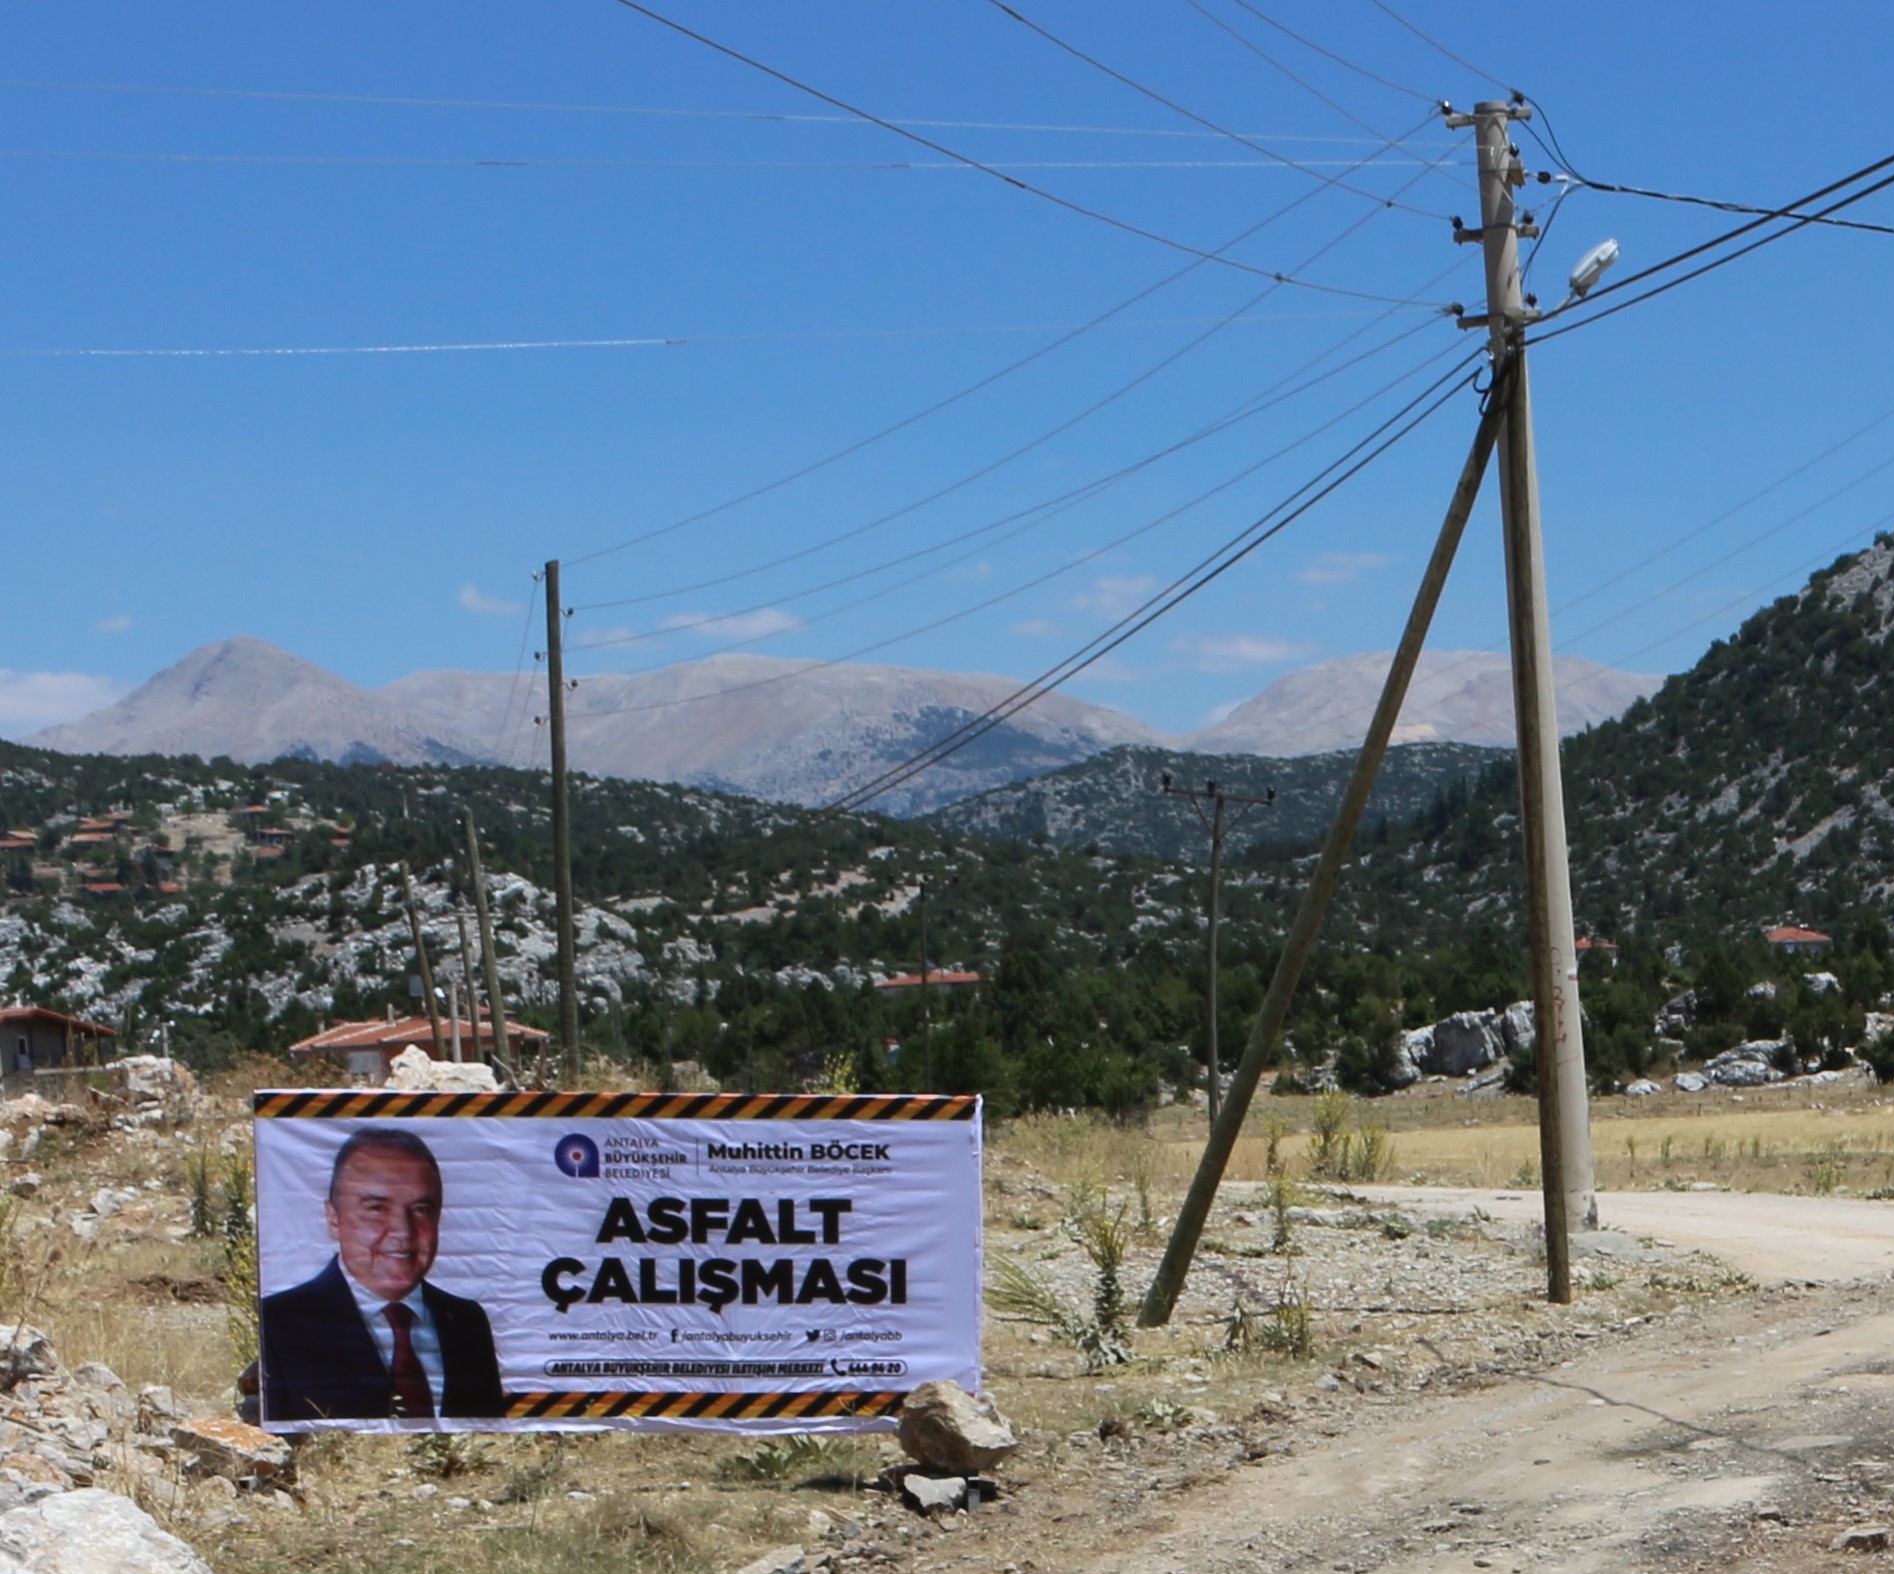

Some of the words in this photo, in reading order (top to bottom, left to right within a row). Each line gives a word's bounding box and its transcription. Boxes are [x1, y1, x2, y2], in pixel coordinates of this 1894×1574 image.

[605, 1138, 658, 1147] ANTALYA
[708, 1142, 803, 1160] Muhittin
[811, 1140, 891, 1160] BÖCEK
[605, 1151, 687, 1166] BÜYÜKŞEHİR
[605, 1167, 670, 1178] BELEDİYESİ
[709, 1165, 746, 1174] Antalya
[596, 1197, 853, 1245] ASFALT
[541, 1257, 907, 1313] ÇALIŞMASI
[549, 1330, 658, 1343] www.antalya.bel.tr
[552, 1363, 602, 1374] ANTALYA
